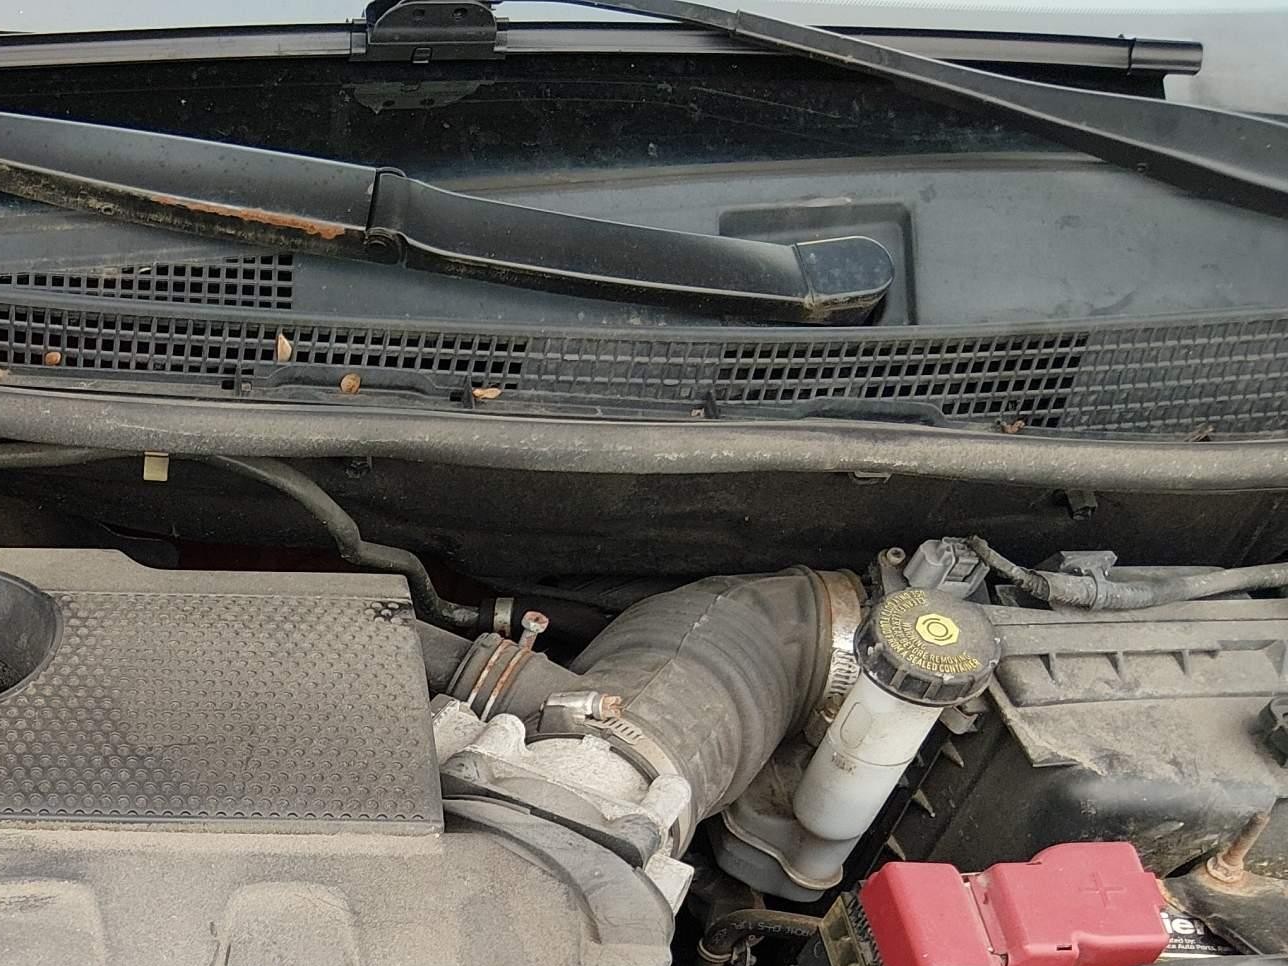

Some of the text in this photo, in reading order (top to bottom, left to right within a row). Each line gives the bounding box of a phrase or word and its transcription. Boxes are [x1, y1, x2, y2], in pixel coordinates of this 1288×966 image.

[902, 621, 927, 650] WARNING
[900, 639, 929, 659] BEFORE
[930, 653, 972, 664] REMOVING
[907, 654, 938, 671] SEALED
[939, 658, 981, 673] CONTAINER
